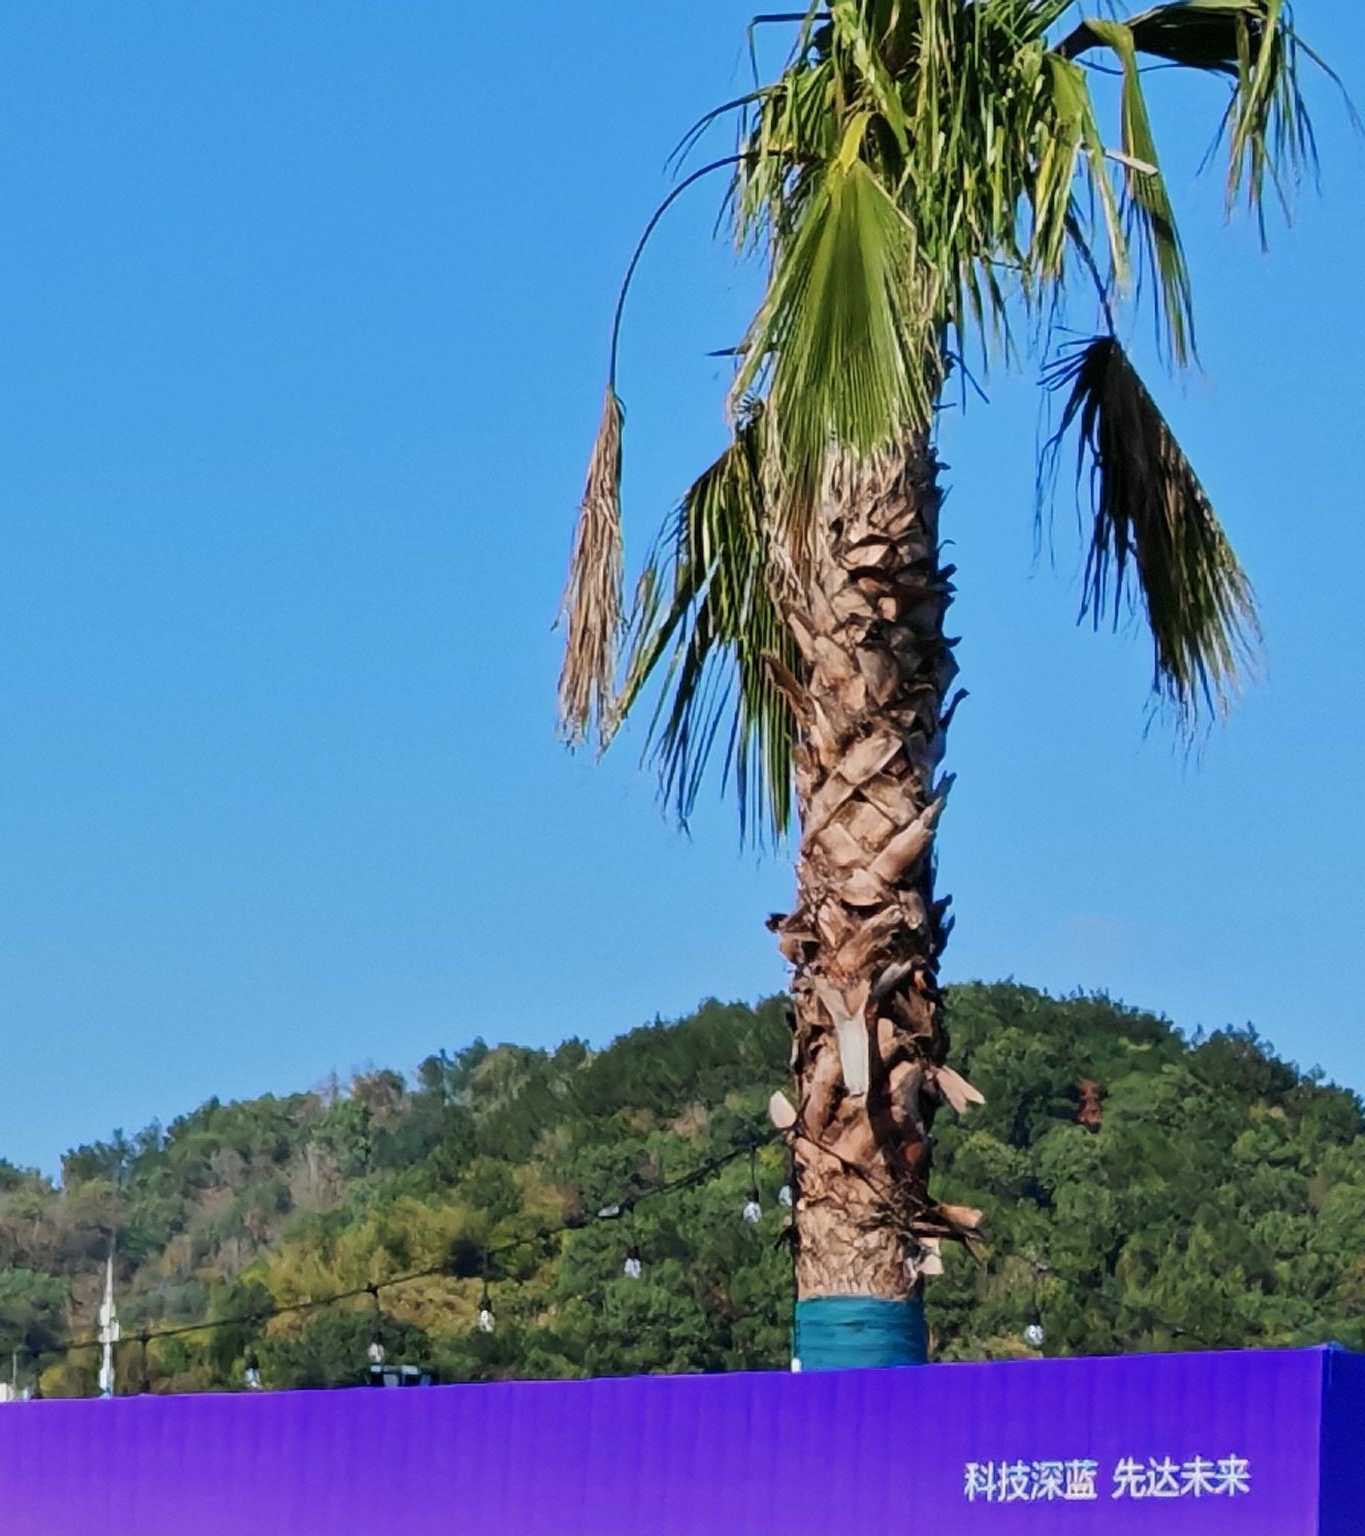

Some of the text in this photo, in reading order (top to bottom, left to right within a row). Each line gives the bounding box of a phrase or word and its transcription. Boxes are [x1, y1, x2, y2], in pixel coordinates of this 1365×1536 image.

[963, 1453, 1252, 1502] 科技深蓝 先达未来
